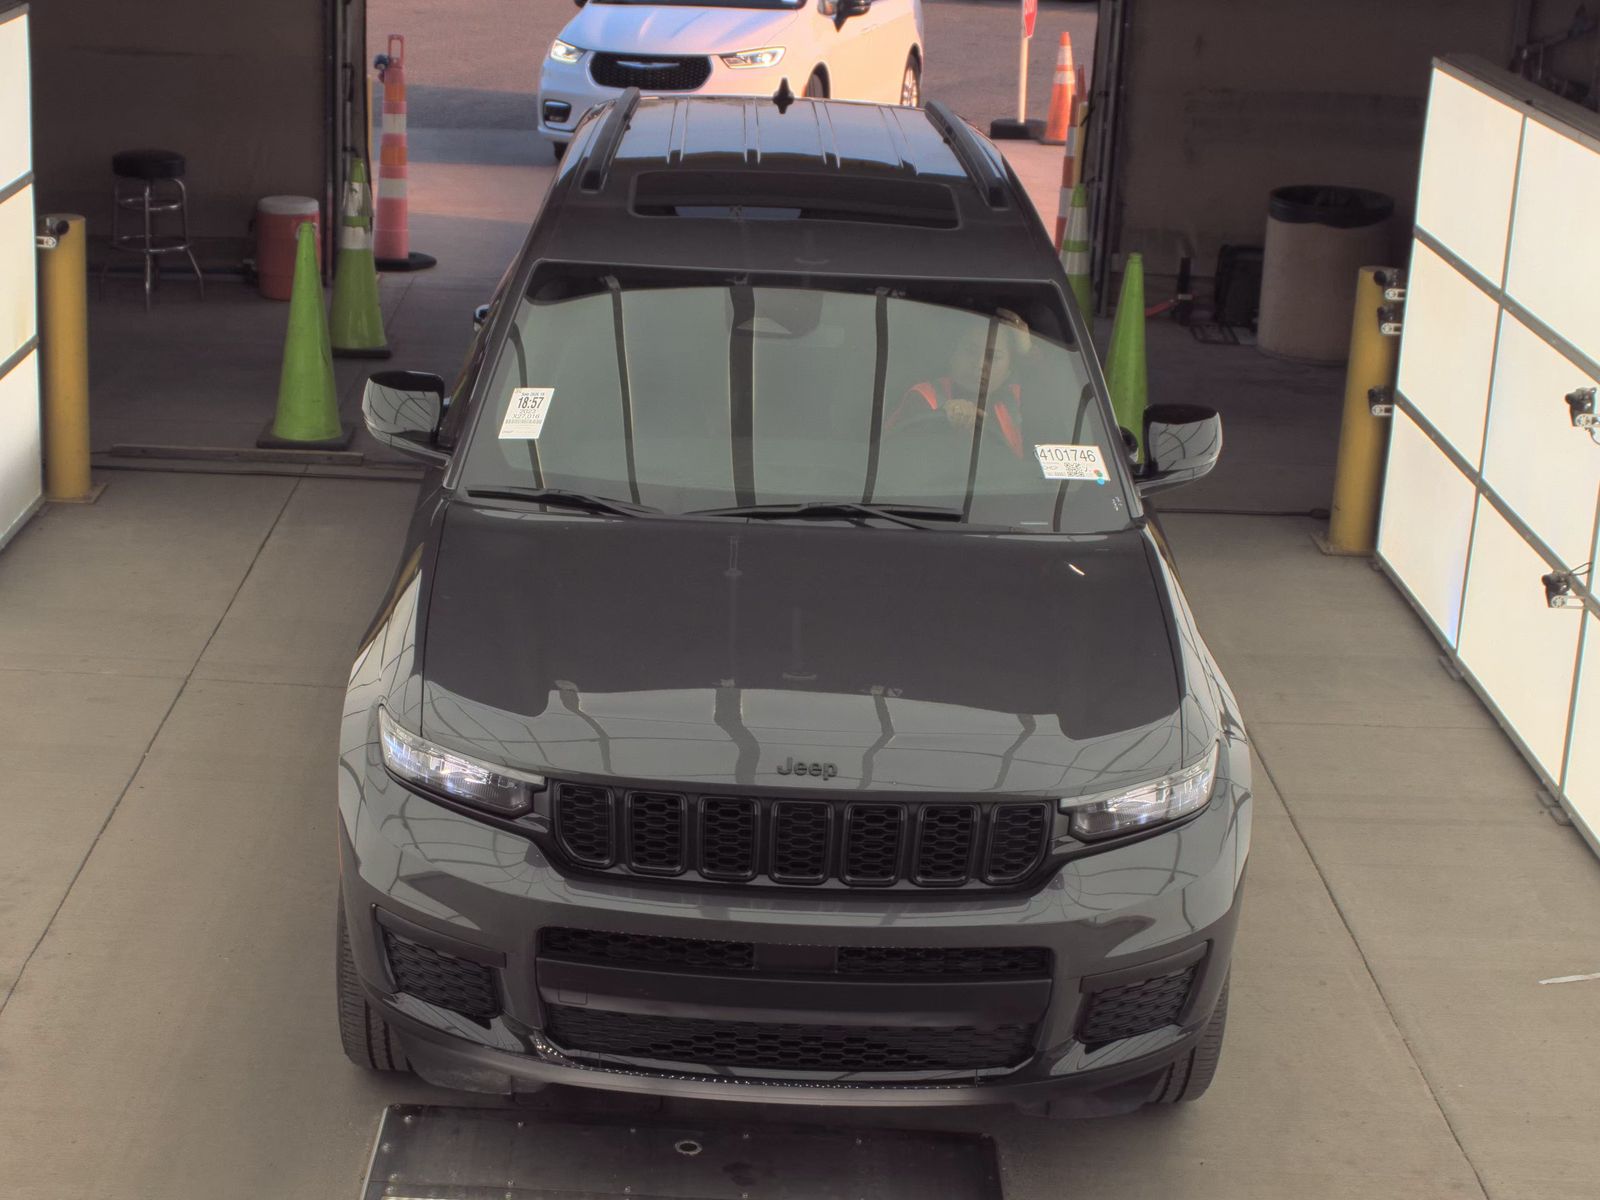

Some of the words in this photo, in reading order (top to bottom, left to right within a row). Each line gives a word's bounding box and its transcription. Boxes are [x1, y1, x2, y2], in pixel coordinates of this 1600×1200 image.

[518, 396, 545, 409] 18:57
[1040, 448, 1096, 462] 4101746
[776, 757, 838, 781] Jeep
